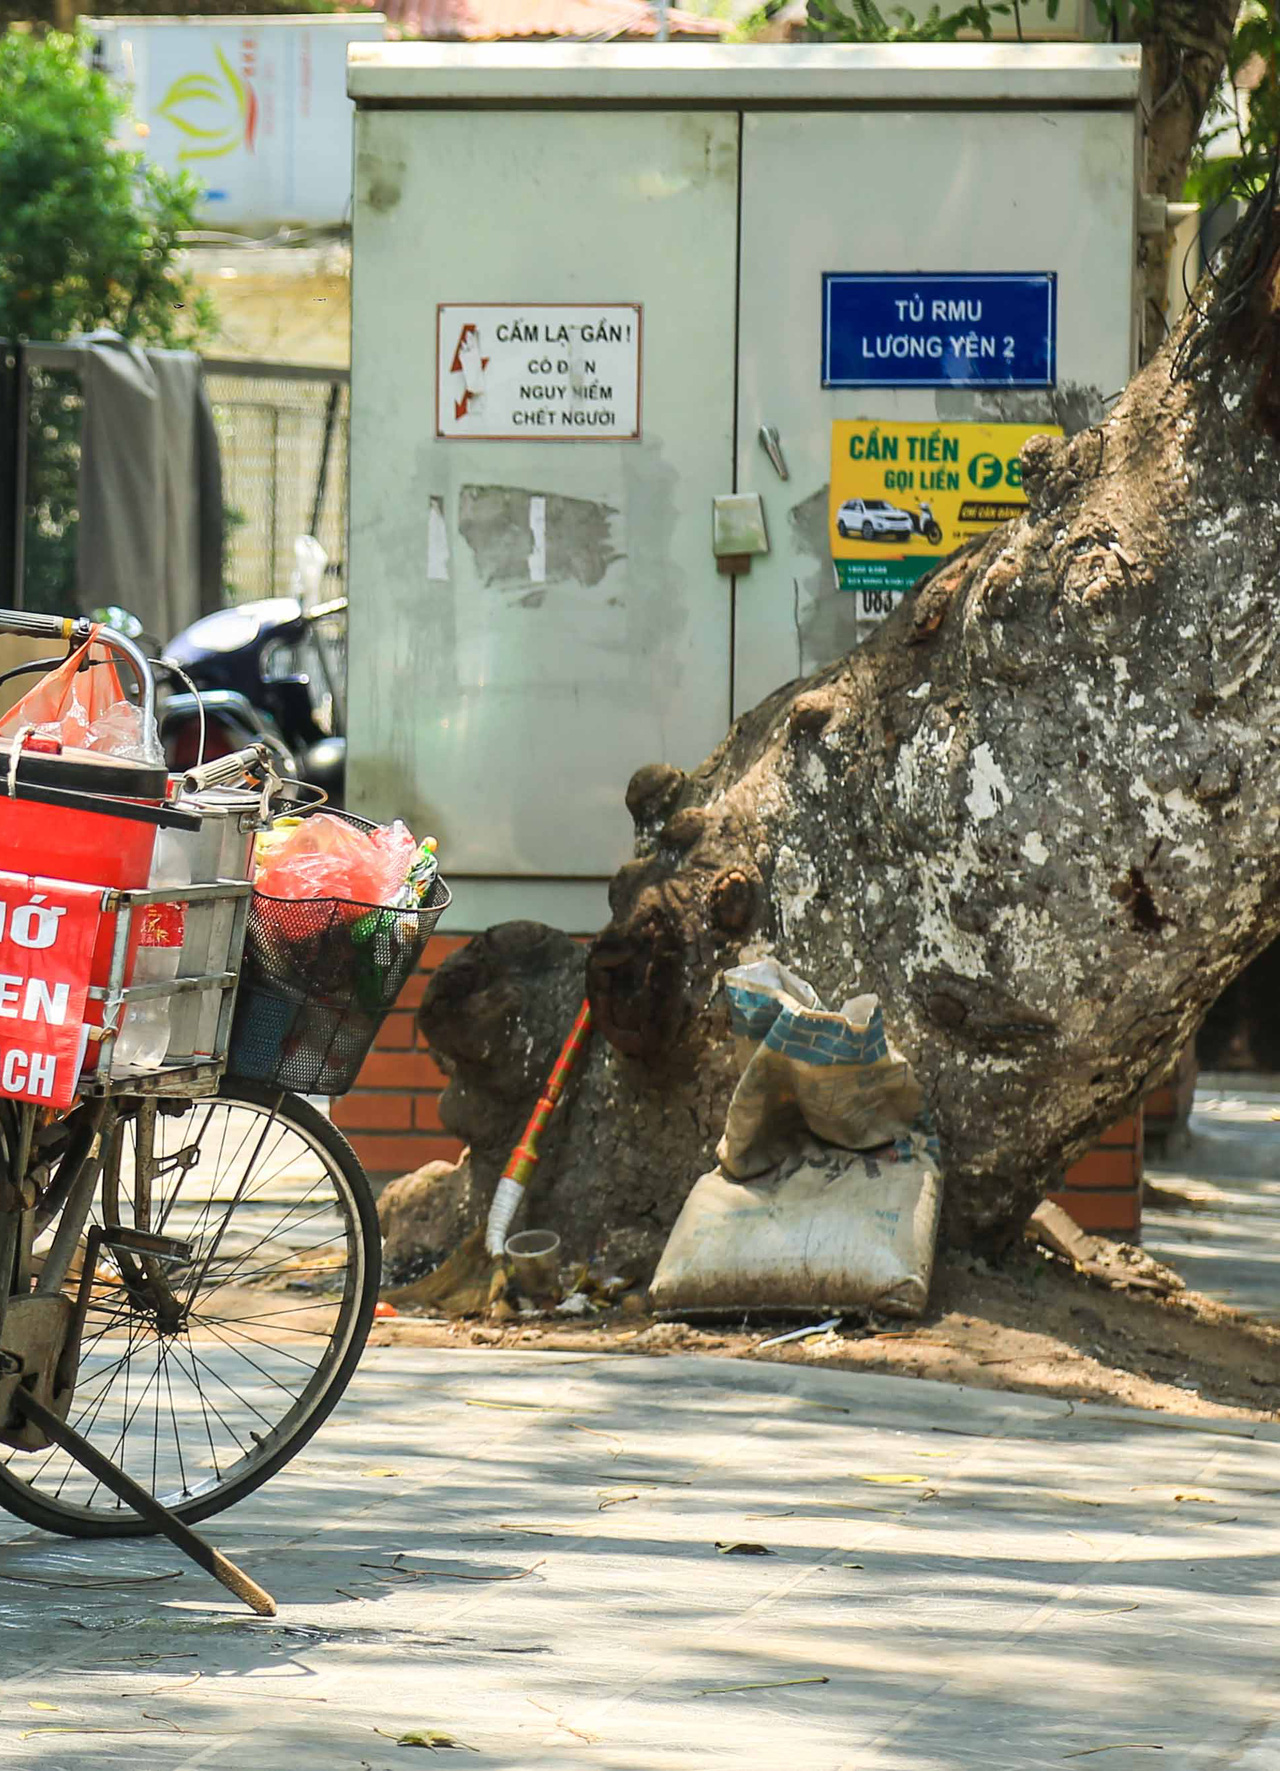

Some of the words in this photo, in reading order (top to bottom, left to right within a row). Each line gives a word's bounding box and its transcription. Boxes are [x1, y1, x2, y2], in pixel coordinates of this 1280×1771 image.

[895, 293, 924, 321] TỦ
[931, 300, 983, 322] RMU
[496, 317, 539, 342] CẤM
[545, 324, 576, 347] LẠ
[862, 333, 942, 358] LƯƠNG
[949, 330, 995, 358] YÊN
[1003, 335, 1015, 358] 2
[528, 355, 552, 374] CÓ
[520, 385, 566, 400] NGUY
[512, 405, 555, 425] CHẾT
[562, 406, 615, 425] NGƯỜI
[884, 468, 914, 493] GỌI
